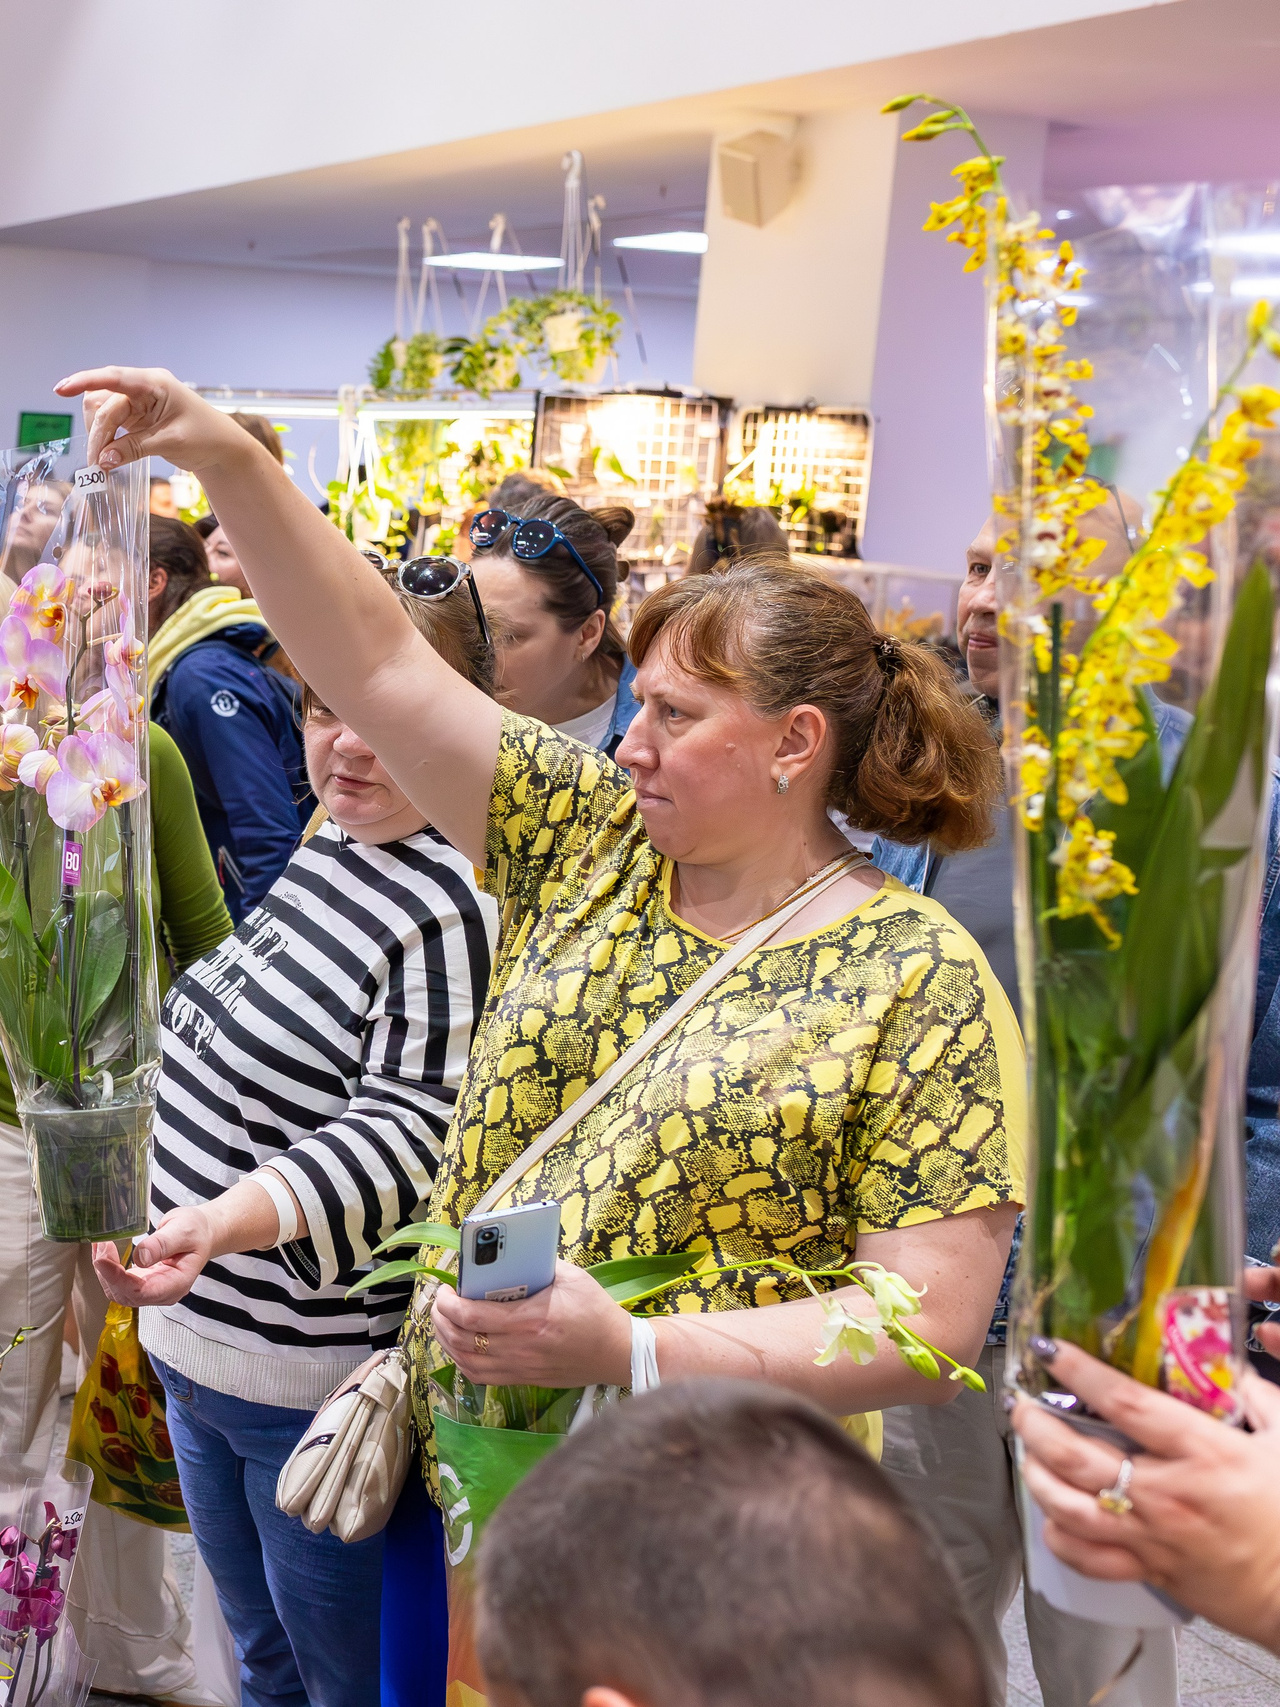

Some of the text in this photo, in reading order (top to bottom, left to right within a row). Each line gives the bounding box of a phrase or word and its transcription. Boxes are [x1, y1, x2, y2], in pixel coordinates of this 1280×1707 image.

[78, 470, 105, 488] 2300
[65, 851, 80, 872] BO
[64, 1511, 83, 1525] 2500
